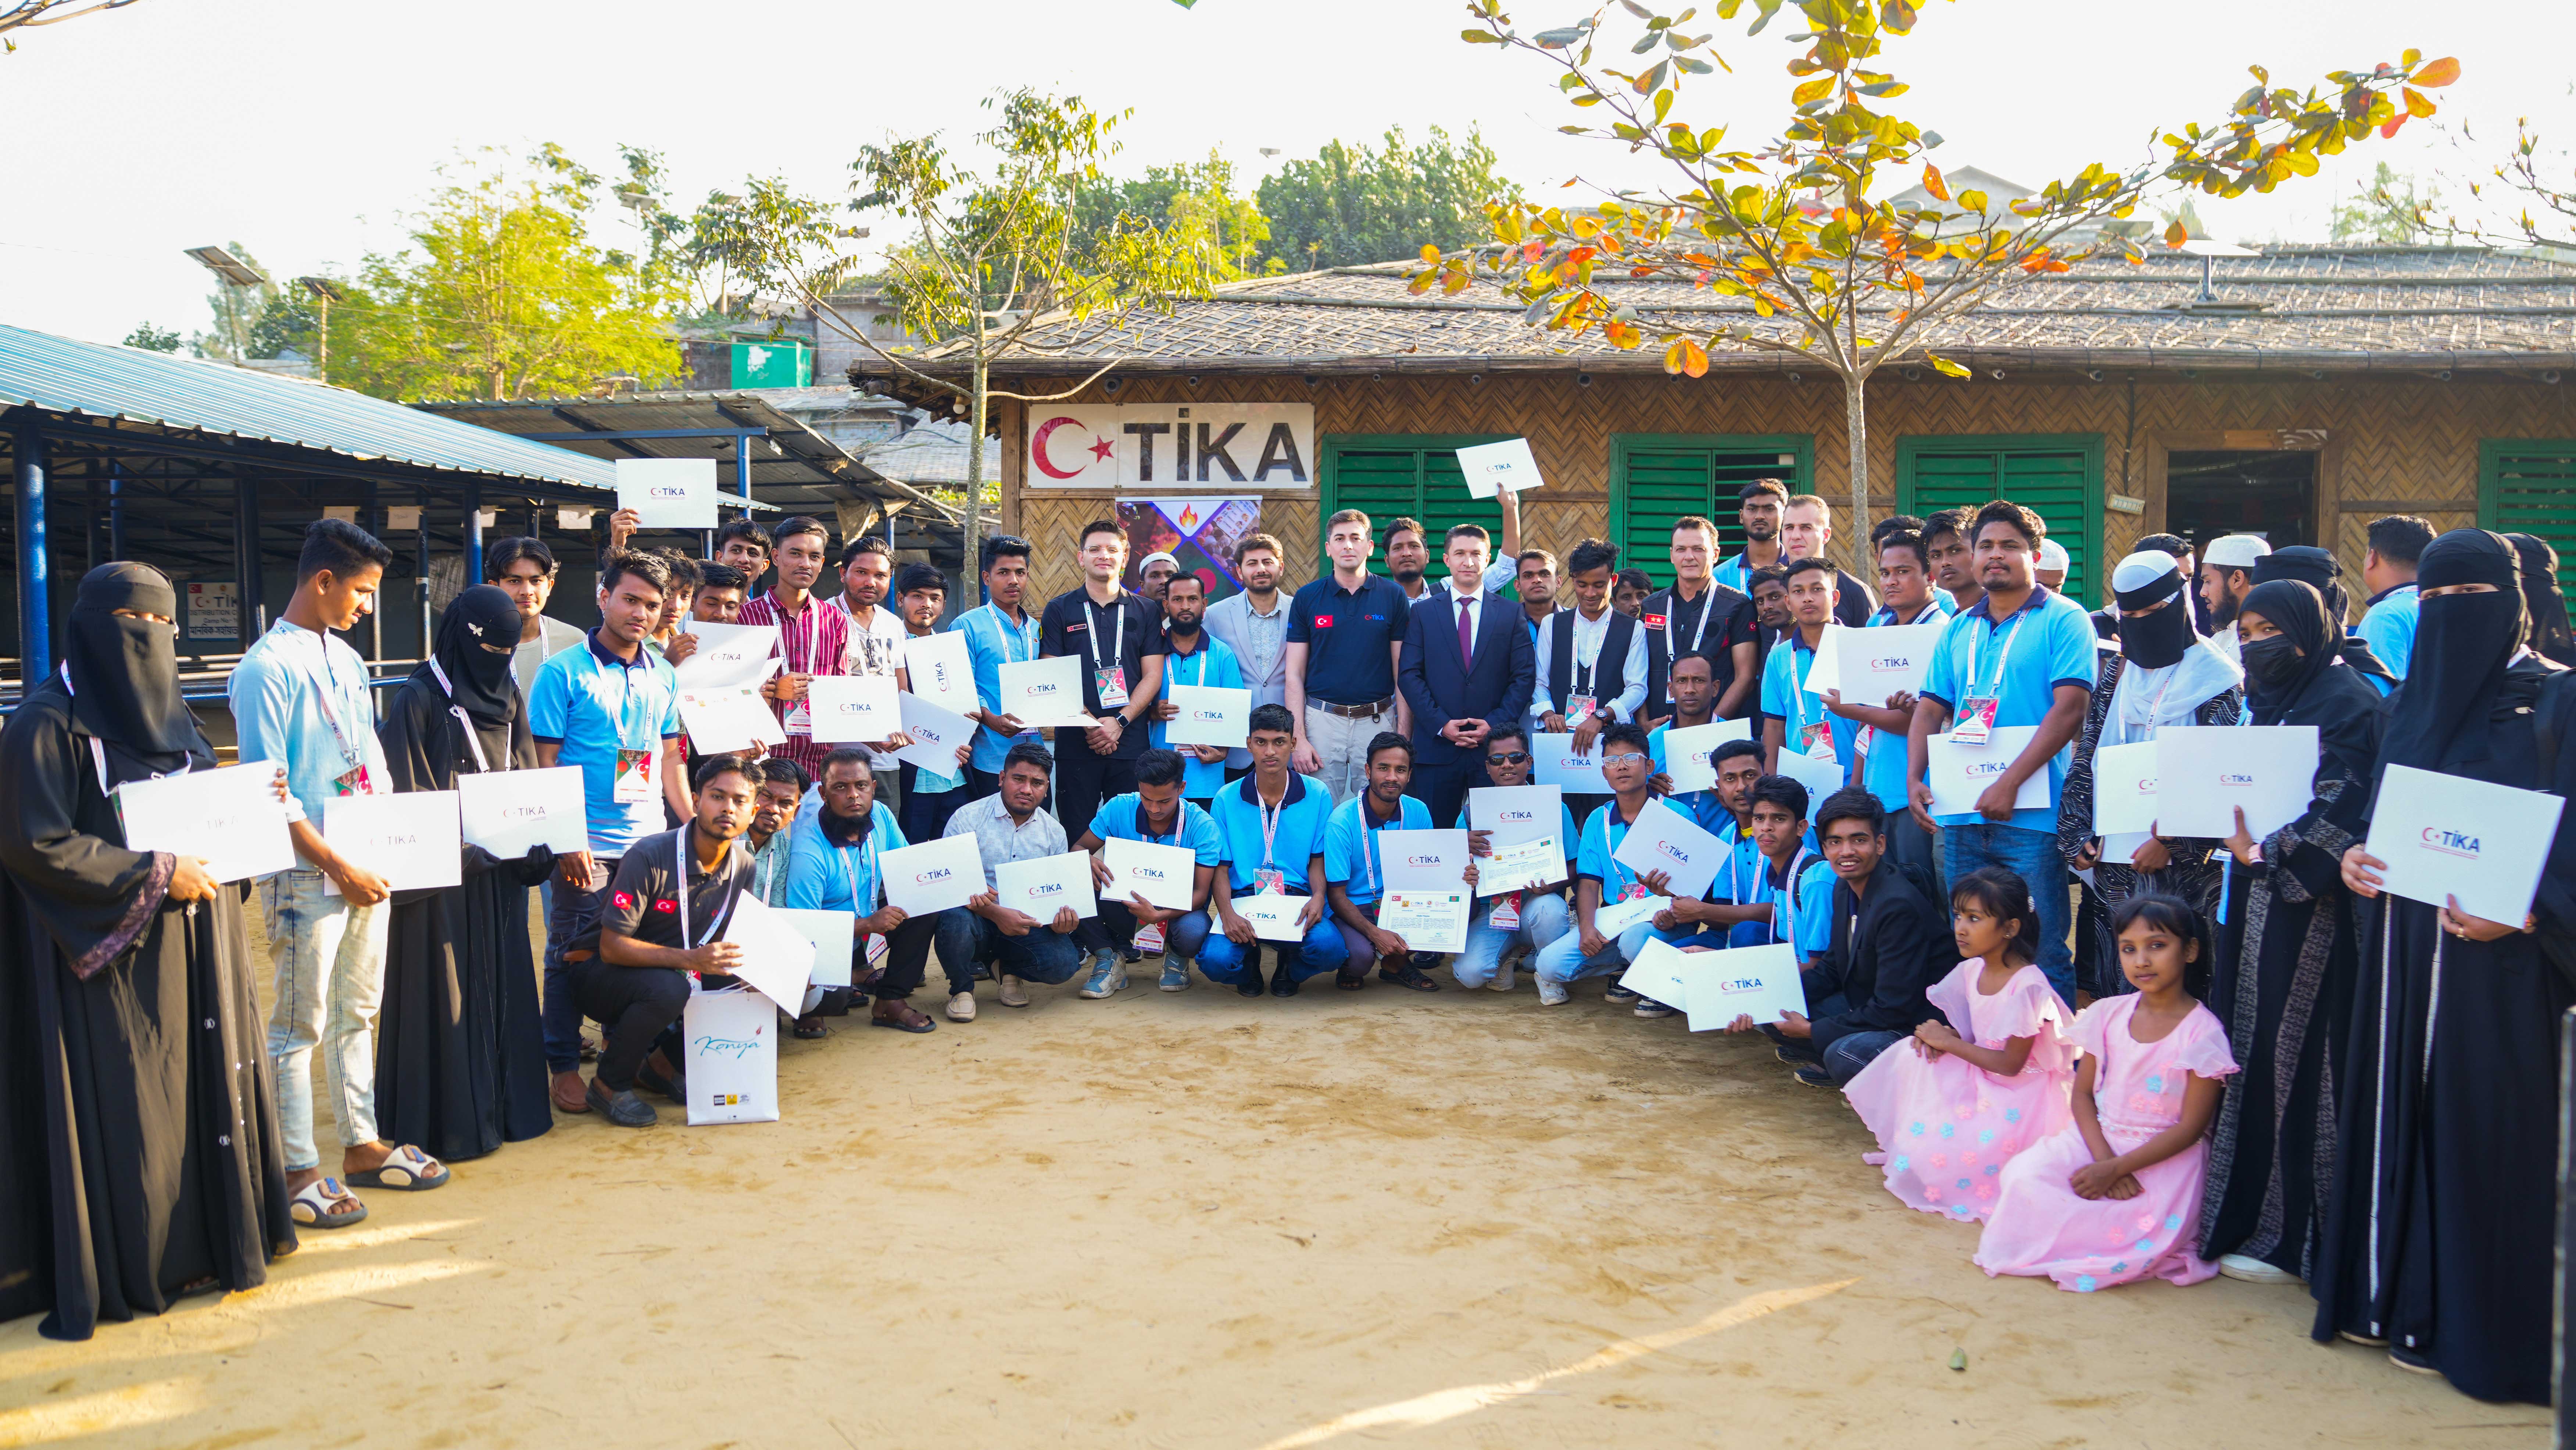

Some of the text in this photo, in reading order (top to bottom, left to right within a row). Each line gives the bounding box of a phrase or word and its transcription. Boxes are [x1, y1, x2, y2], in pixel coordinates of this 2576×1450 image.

[1124, 408, 1307, 482] TİKA
[663, 486, 685, 496] TİKA
[1884, 657, 1909, 667] TİKA
[936, 662, 945, 683] TİKA
[1037, 683, 1056, 692] TİKA
[851, 702, 871, 711] TİKA
[1204, 711, 1223, 719] TİKA
[922, 729, 940, 742] TİKA
[1979, 761, 2007, 773] TİKA
[2232, 774, 2253, 783] TİKA
[1511, 810, 1532, 818] TİKA
[2442, 830, 2480, 853] TİKA
[1419, 855, 1440, 863] TİKA
[1669, 845, 1688, 863] TİKA
[927, 868, 951, 880] TİKA
[1144, 868, 1163, 878] TİKA
[1040, 883, 1062, 893] TİKA
[1734, 978, 1763, 989] TİKA
[694, 1036, 761, 1059] Konya
